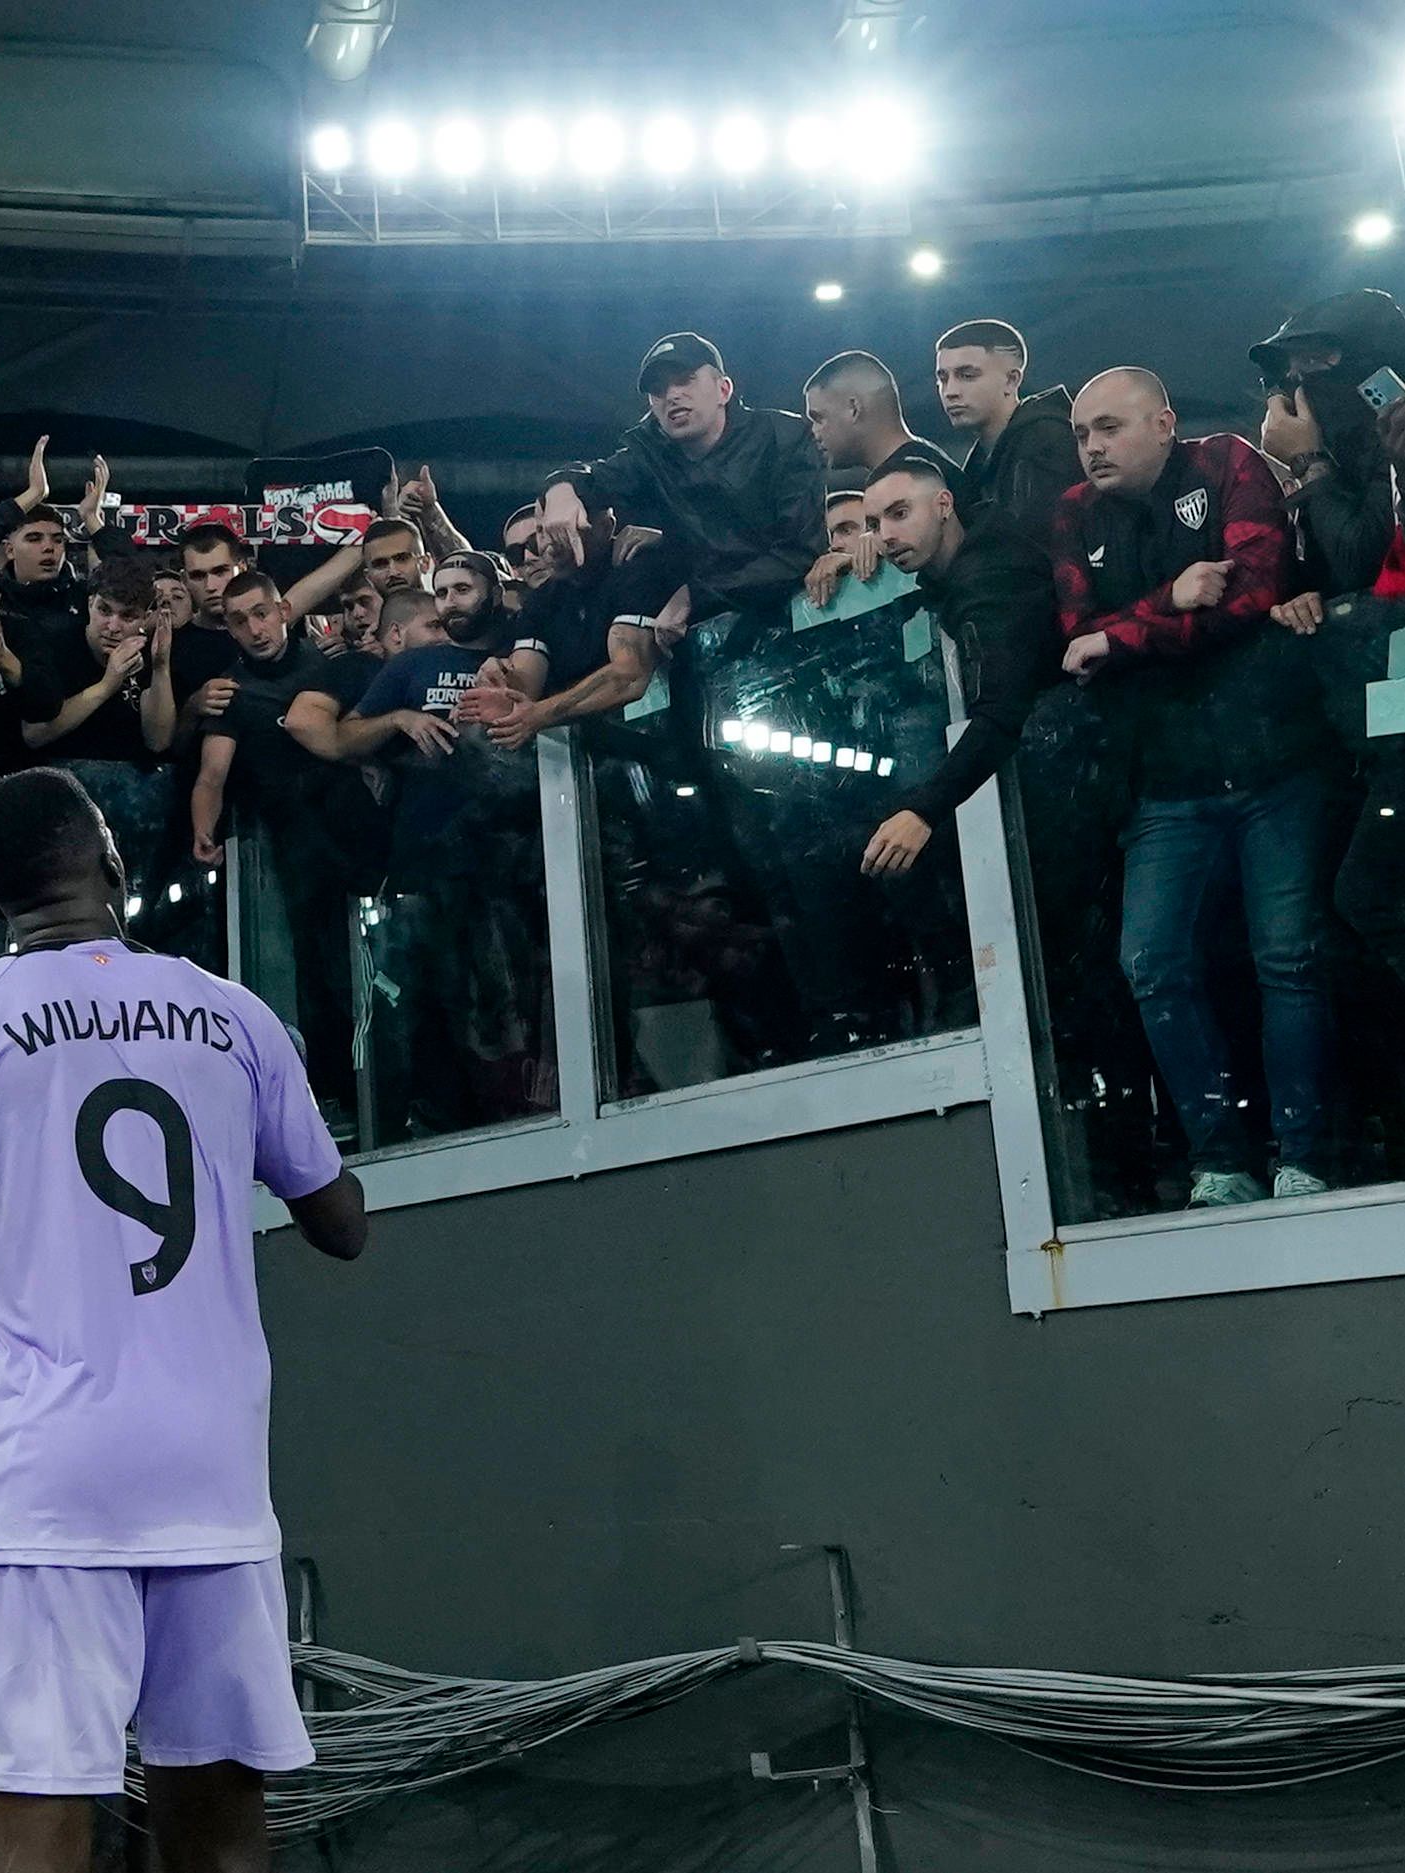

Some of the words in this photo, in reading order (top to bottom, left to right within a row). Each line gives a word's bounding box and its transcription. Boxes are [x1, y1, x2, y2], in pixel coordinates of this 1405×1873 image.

[437, 672, 476, 687] ULTR
[2, 999, 233, 1056] WILLIAMS
[75, 1078, 195, 1296] 9
